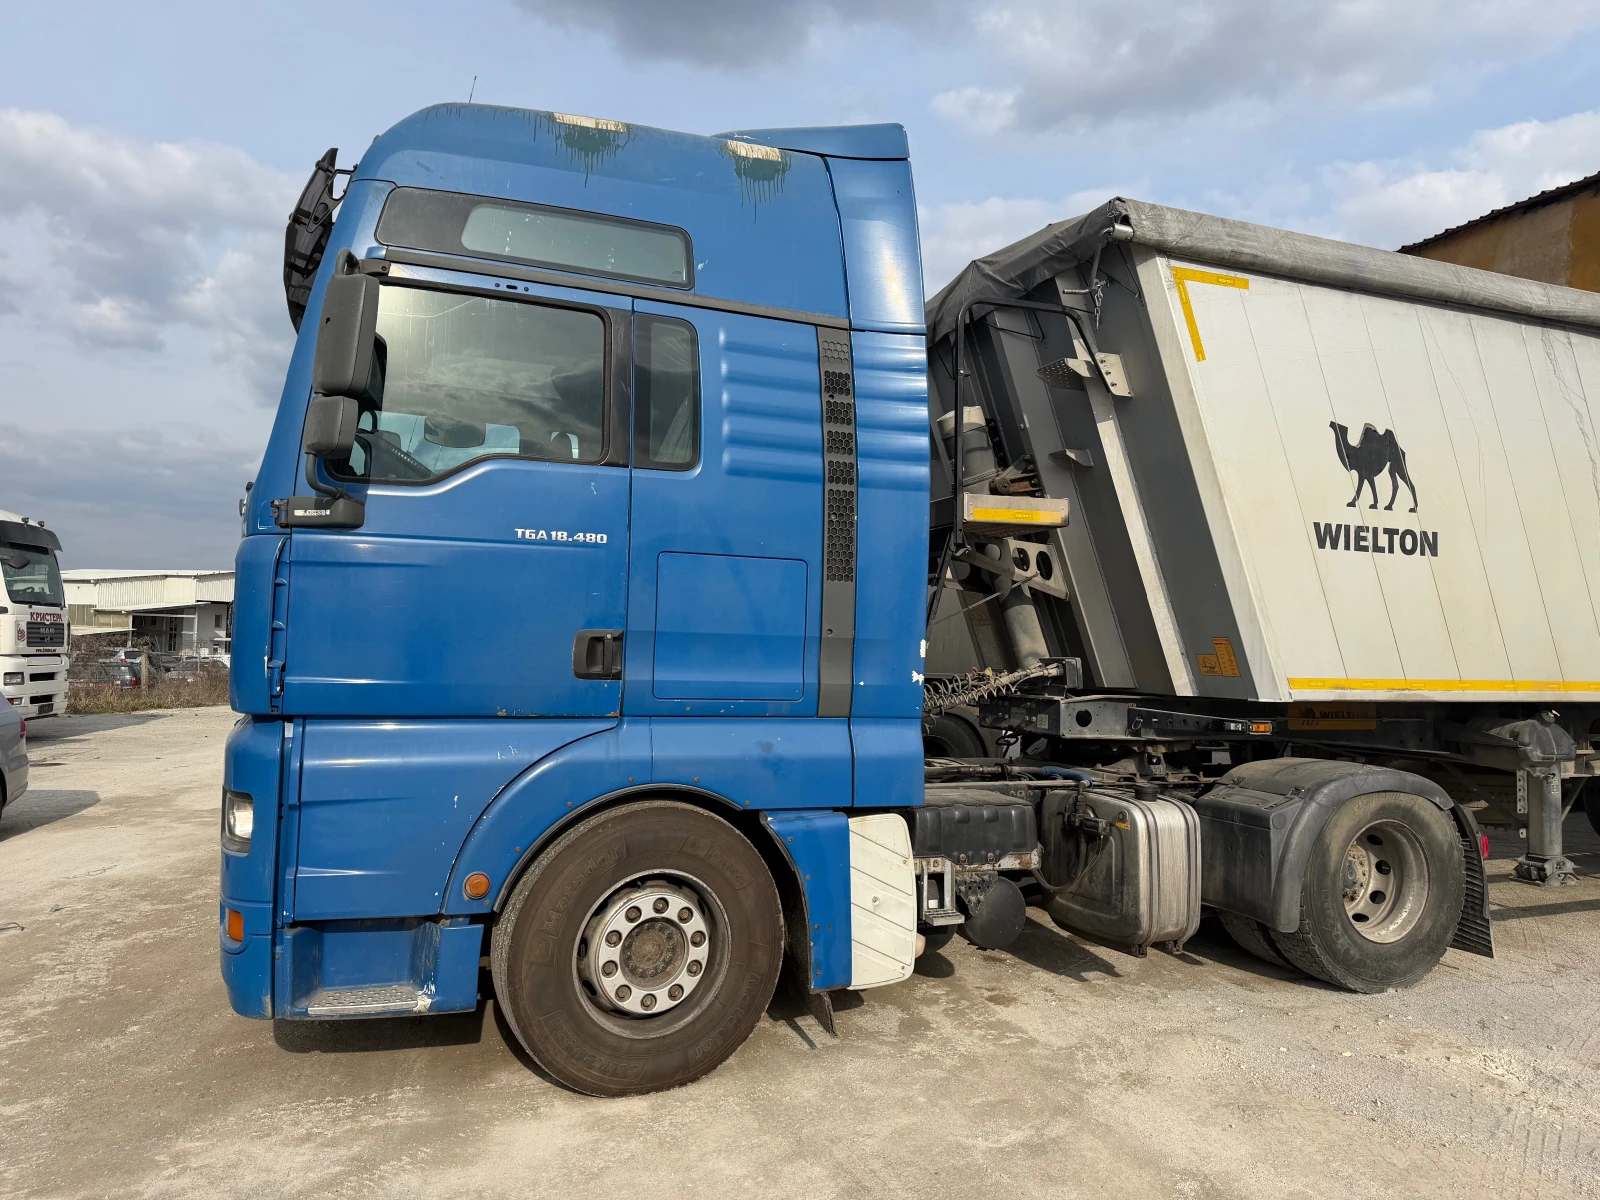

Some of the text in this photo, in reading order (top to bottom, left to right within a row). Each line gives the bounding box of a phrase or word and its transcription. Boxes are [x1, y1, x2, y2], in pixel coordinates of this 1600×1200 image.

[514, 528, 608, 544] TGA 18.480
[1312, 521, 1439, 558] WIELTON
[30, 611, 62, 622] КРИСТЕРА
[542, 847, 620, 931] Matador
